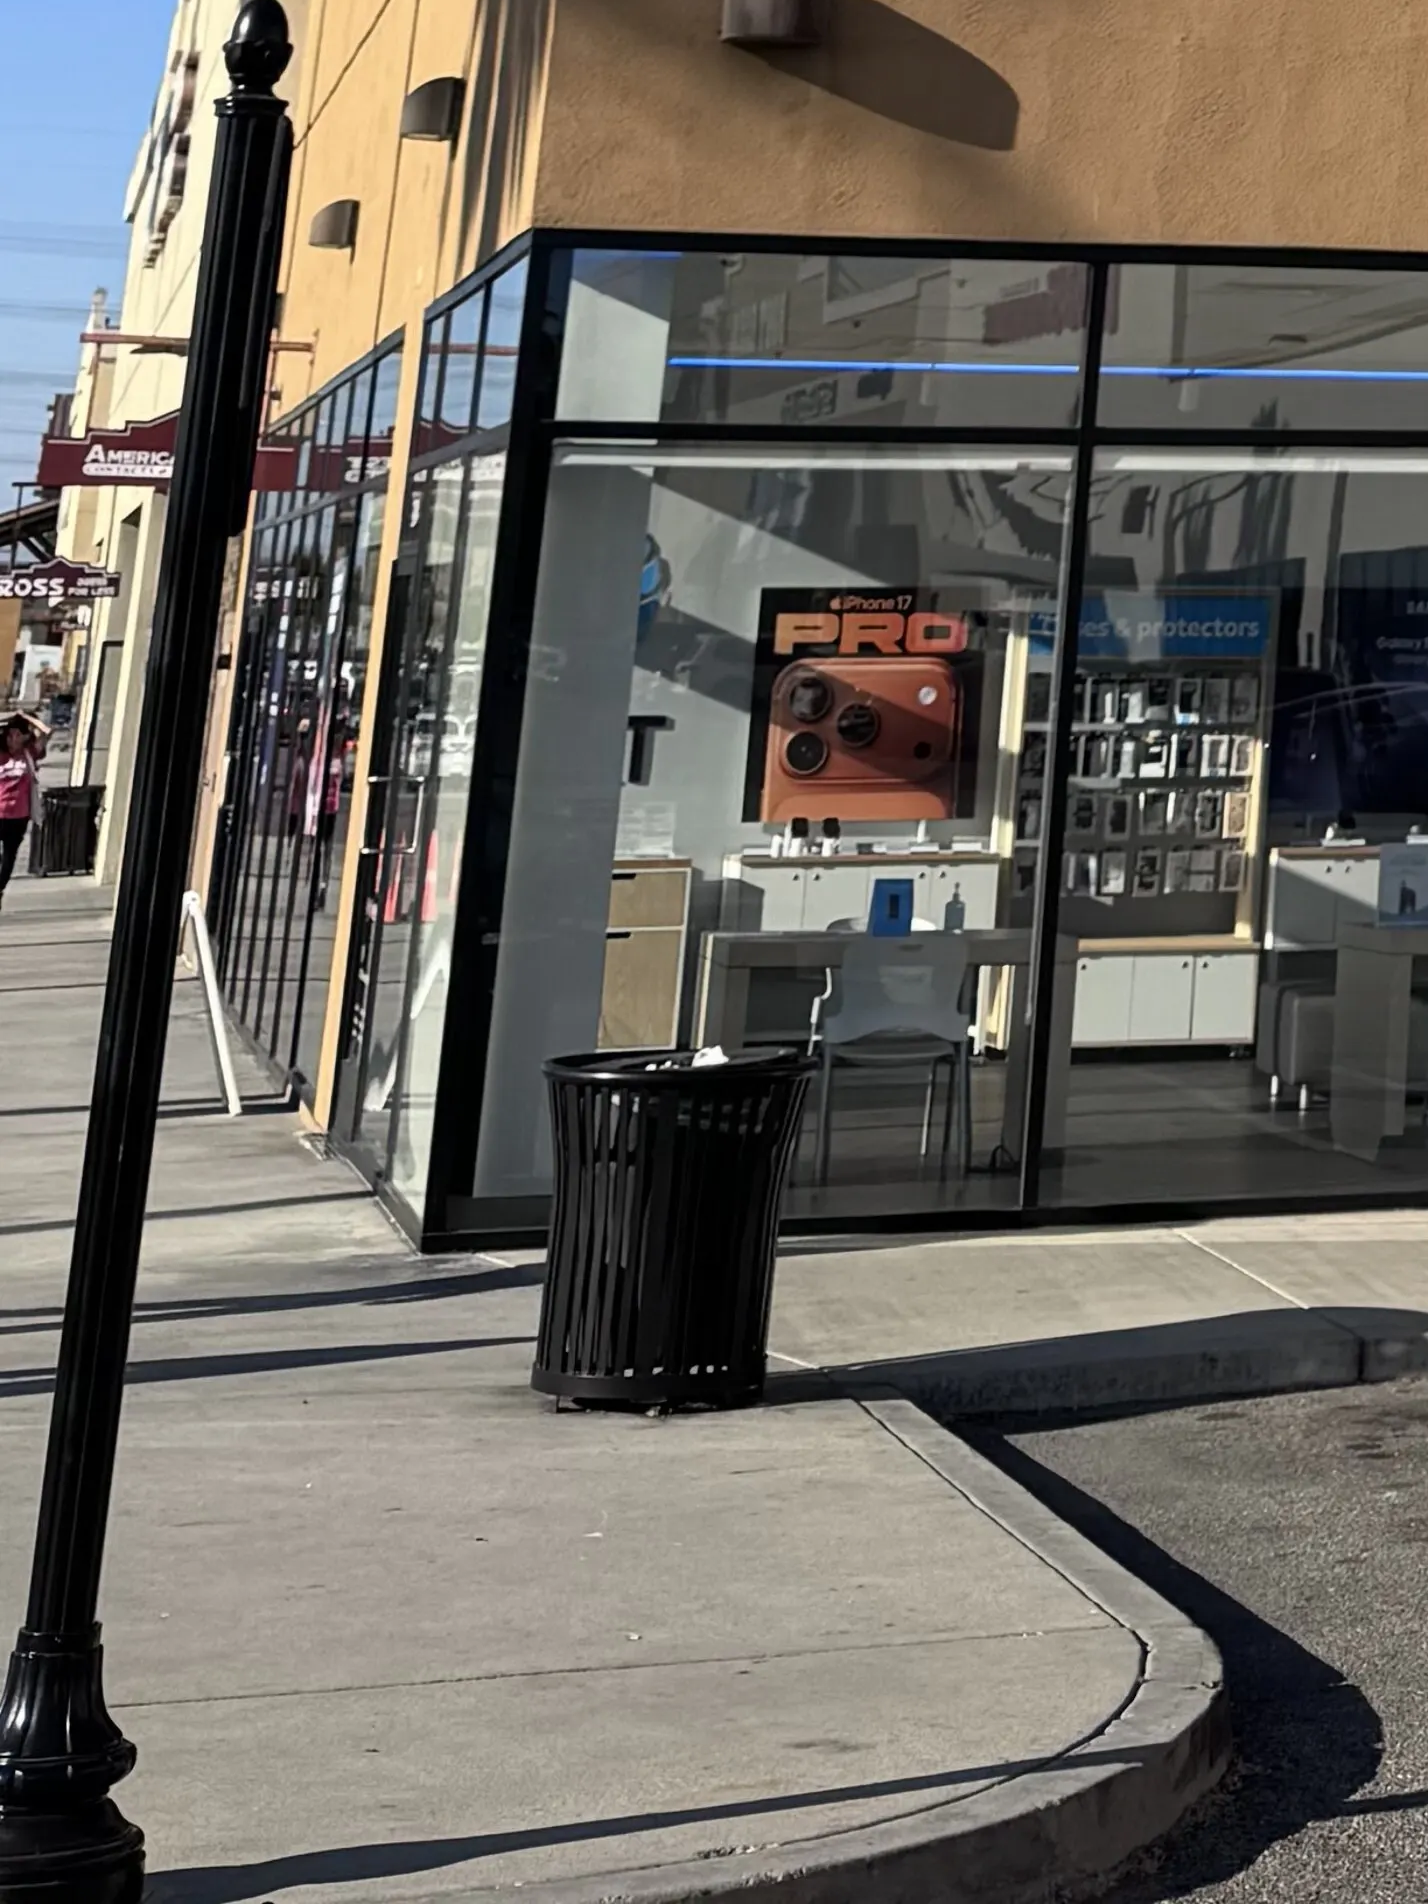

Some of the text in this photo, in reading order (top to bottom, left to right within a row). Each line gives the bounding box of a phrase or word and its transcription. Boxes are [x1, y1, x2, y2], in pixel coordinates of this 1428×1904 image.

[84, 443, 175, 466] AMERIC
[842, 595, 913, 611] iPhone 17
[773, 612, 968, 655] PRO
[1136, 617, 1260, 643] protectors
